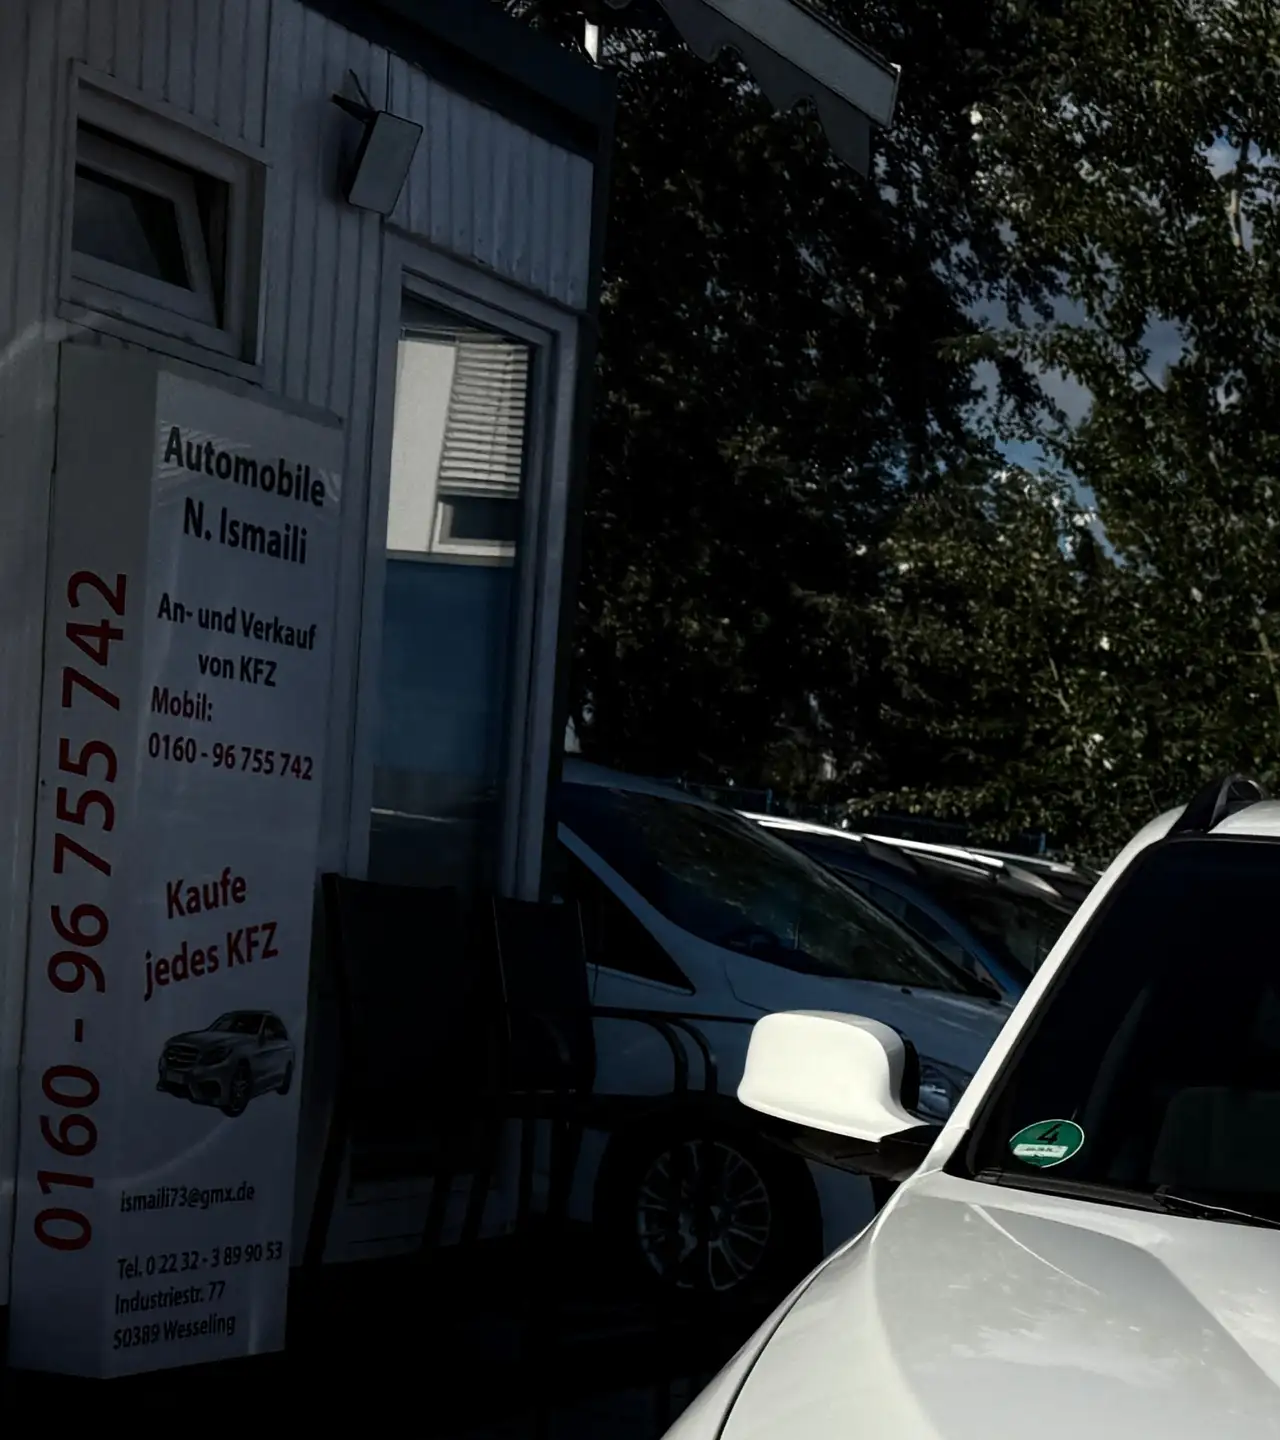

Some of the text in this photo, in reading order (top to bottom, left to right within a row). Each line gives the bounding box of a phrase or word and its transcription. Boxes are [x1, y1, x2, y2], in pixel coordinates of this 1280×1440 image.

[164, 426, 325, 507] Automobile
[184, 497, 307, 564] N. Ismaili
[62, 571, 127, 711] 742
[157, 593, 316, 650] An- und Verkauf
[198, 654, 277, 687] von KFZ
[151, 686, 213, 722] Mobil:
[148, 732, 196, 763] 0160
[213, 743, 235, 769] 96
[241, 746, 274, 774] 755
[280, 753, 313, 780] 742
[54, 737, 118, 877] 755
[167, 867, 246, 919] Kaufe
[47, 903, 109, 994] 96
[144, 922, 279, 1002] jedes KFZ
[34, 1063, 101, 1251] 0160
[1037, 1123, 1062, 1143] 4
[120, 1181, 255, 1212] ismaili73@gmx.de
[117, 1255, 142, 1280] Tel.
[146, 1256, 155, 1276] 0
[158, 1253, 178, 1274] 22
[181, 1251, 199, 1271] 32
[115, 1280, 226, 1315] Industriestr. 77
[113, 1313, 236, 1350] 50389 Wesseling
